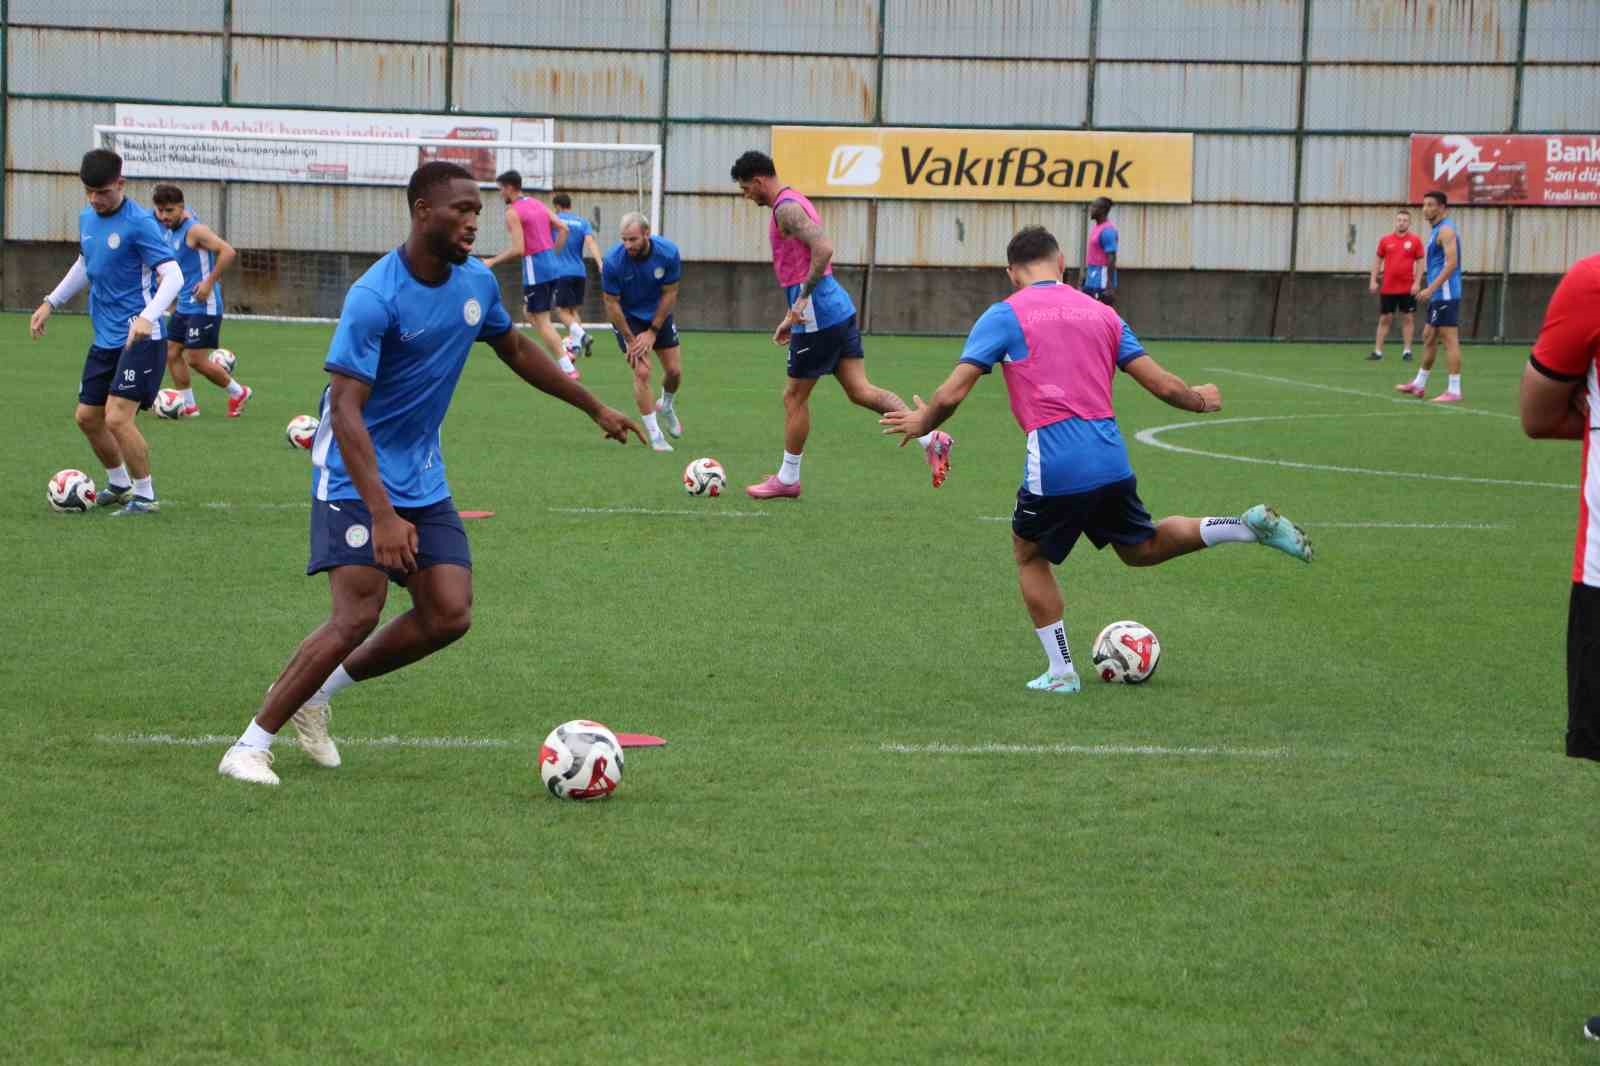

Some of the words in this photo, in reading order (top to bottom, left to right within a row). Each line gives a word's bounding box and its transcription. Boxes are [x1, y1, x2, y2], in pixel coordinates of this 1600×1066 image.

[901, 146, 1133, 188] VakıfBank
[1545, 166, 1577, 183] Seni
[1543, 188, 1572, 202] Kredi
[123, 369, 136, 381] 18
